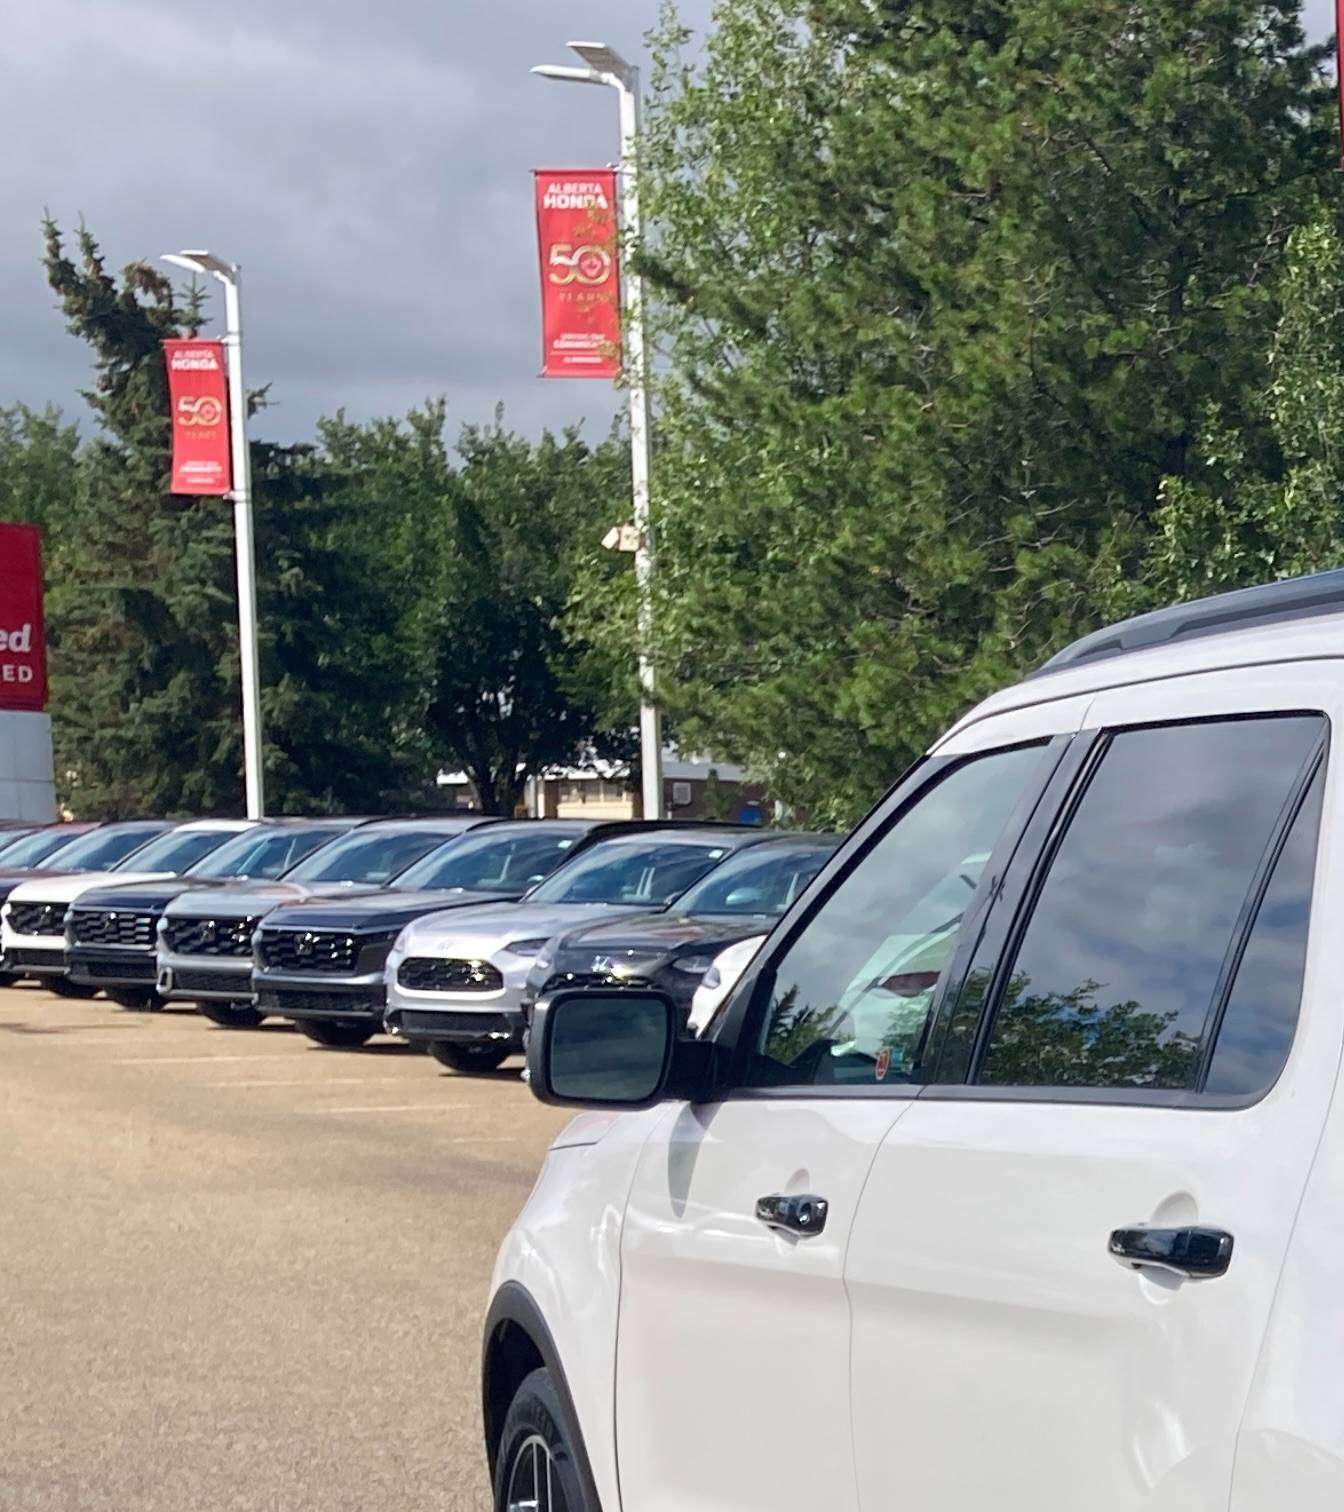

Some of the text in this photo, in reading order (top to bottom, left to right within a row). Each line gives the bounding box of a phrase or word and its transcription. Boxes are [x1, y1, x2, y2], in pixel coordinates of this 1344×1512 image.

[547, 182, 603, 193] ALBERTA
[543, 194, 608, 209] HONDA
[549, 244, 611, 286] 50
[178, 396, 222, 427] 50
